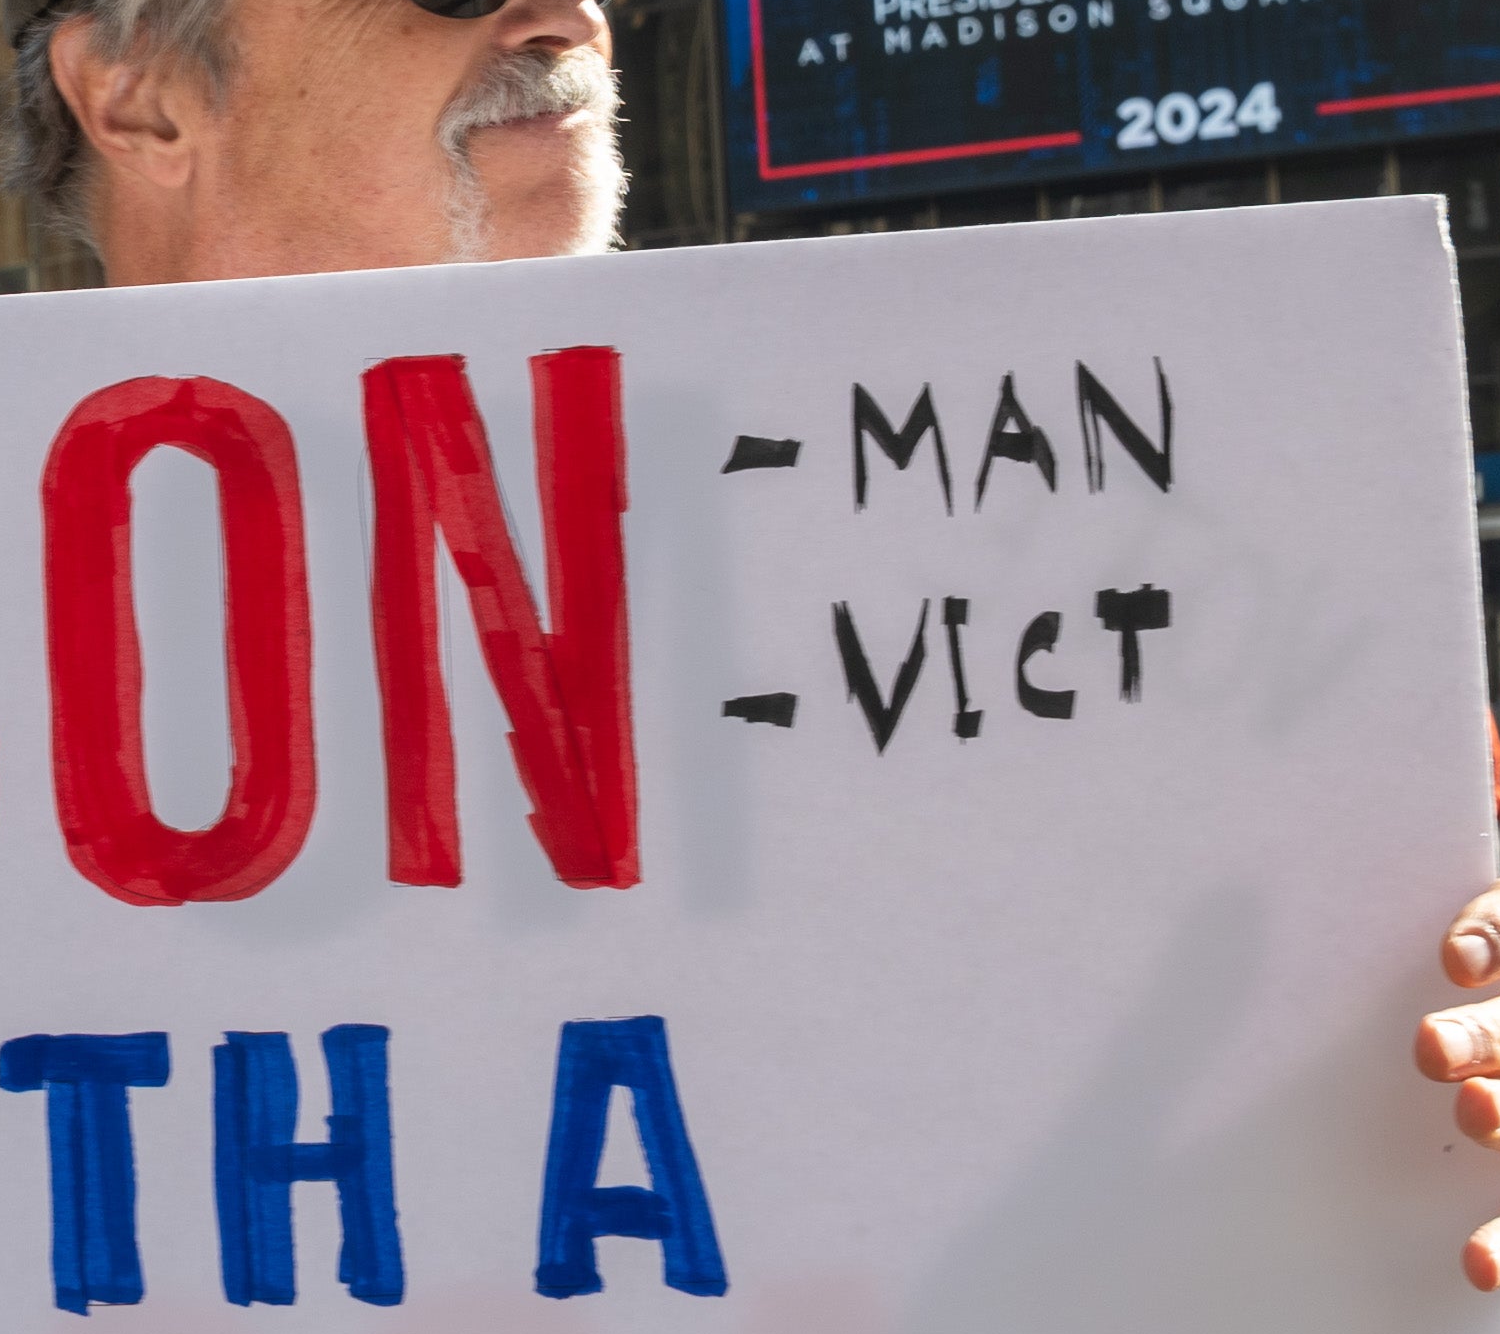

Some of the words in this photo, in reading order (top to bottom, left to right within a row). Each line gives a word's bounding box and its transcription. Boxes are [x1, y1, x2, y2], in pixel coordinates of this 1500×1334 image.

[799, 32, 853, 67] AT
[1115, 82, 1283, 151] 2024
[533, 1015, 729, 1299] A
